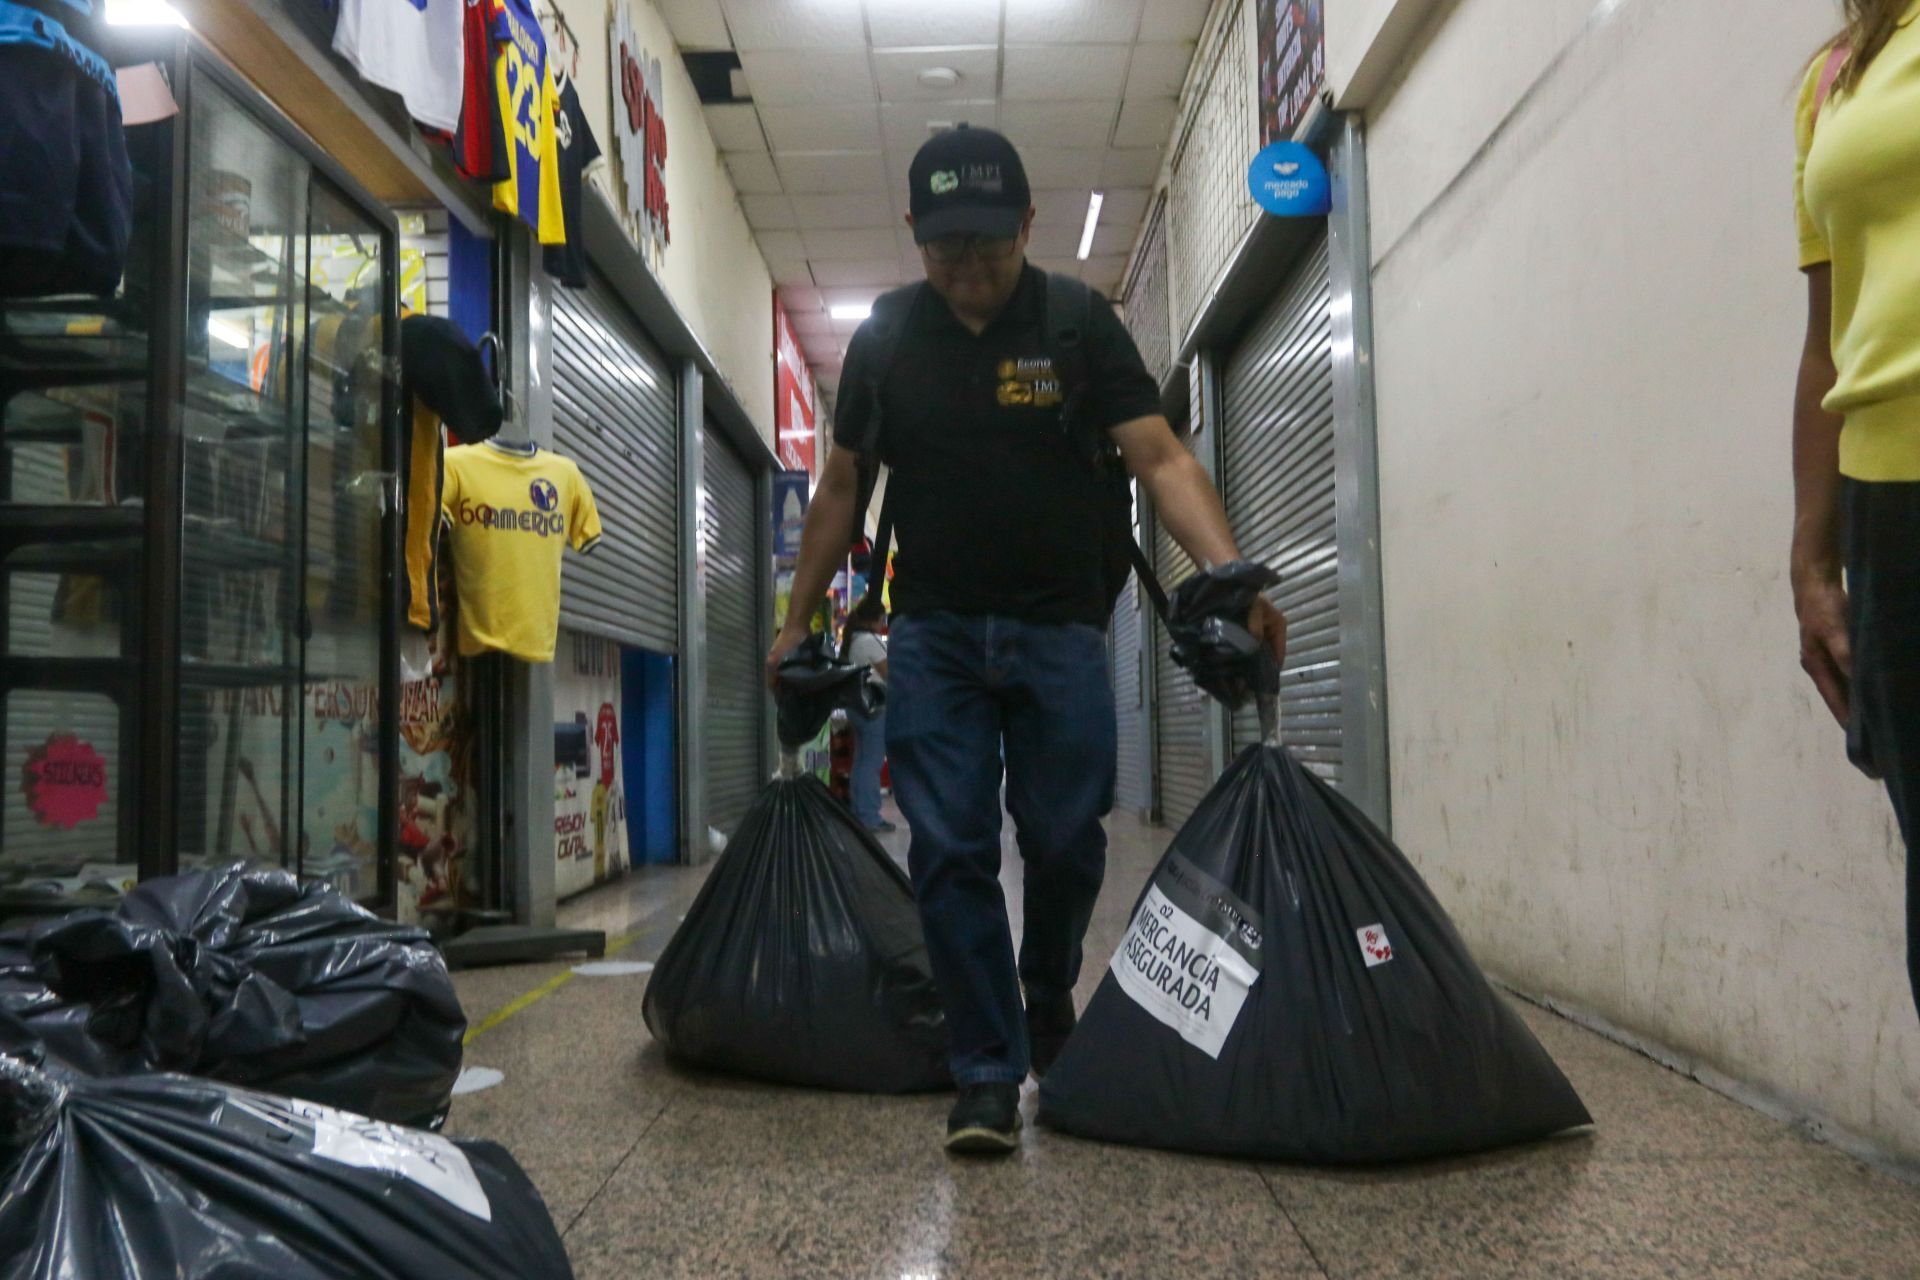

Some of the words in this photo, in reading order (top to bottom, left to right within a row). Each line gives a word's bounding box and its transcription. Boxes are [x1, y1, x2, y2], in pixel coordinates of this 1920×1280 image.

[507, 41, 542, 161] 23
[1264, 180, 1309, 191] mercado
[1274, 187, 1300, 199] pago
[1124, 930, 1211, 1022] ASEGURADA
